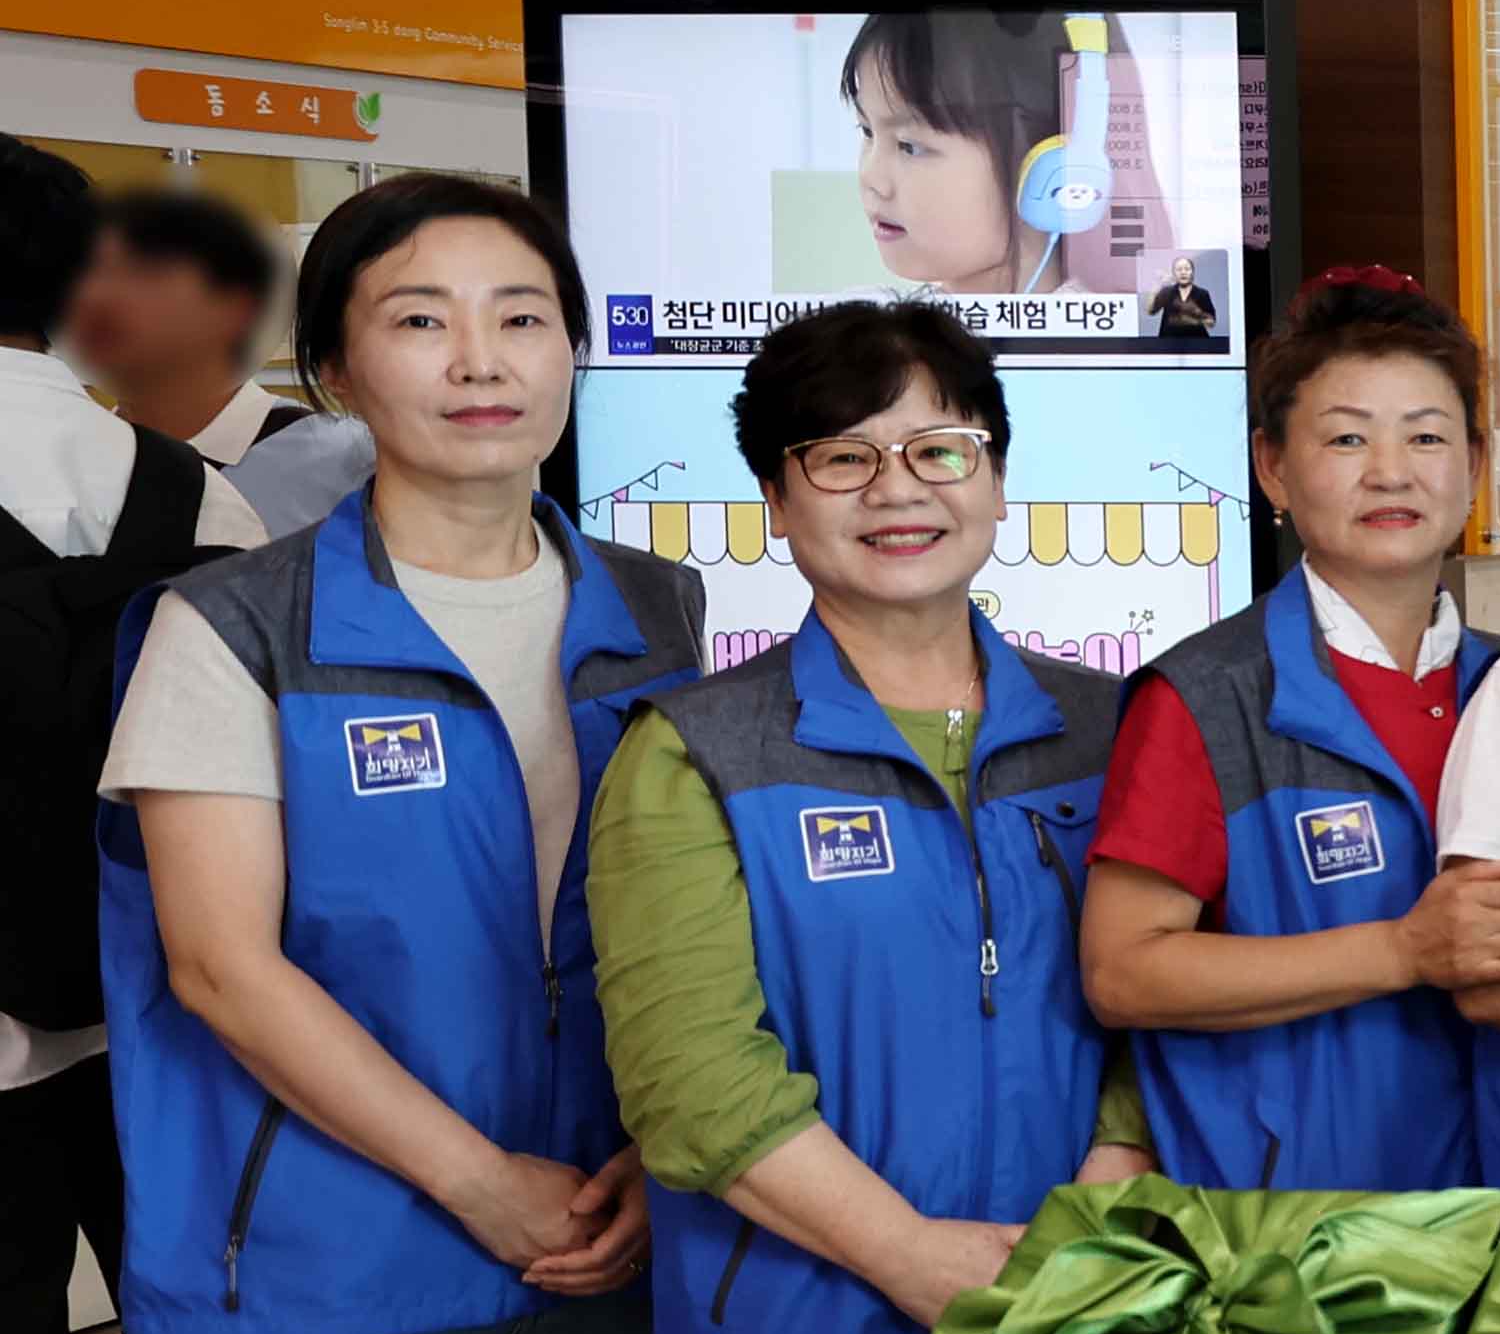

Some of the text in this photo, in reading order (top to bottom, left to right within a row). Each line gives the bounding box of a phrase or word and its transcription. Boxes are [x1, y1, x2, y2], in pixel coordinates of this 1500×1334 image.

[424, 26, 485, 51] Community
[612, 305, 649, 327] 530
[663, 301, 715, 330] 첨단
[995, 300, 1047, 331] 체험
[1056, 301, 1125, 331] '다양'
[726, 338, 750, 353] 기준
